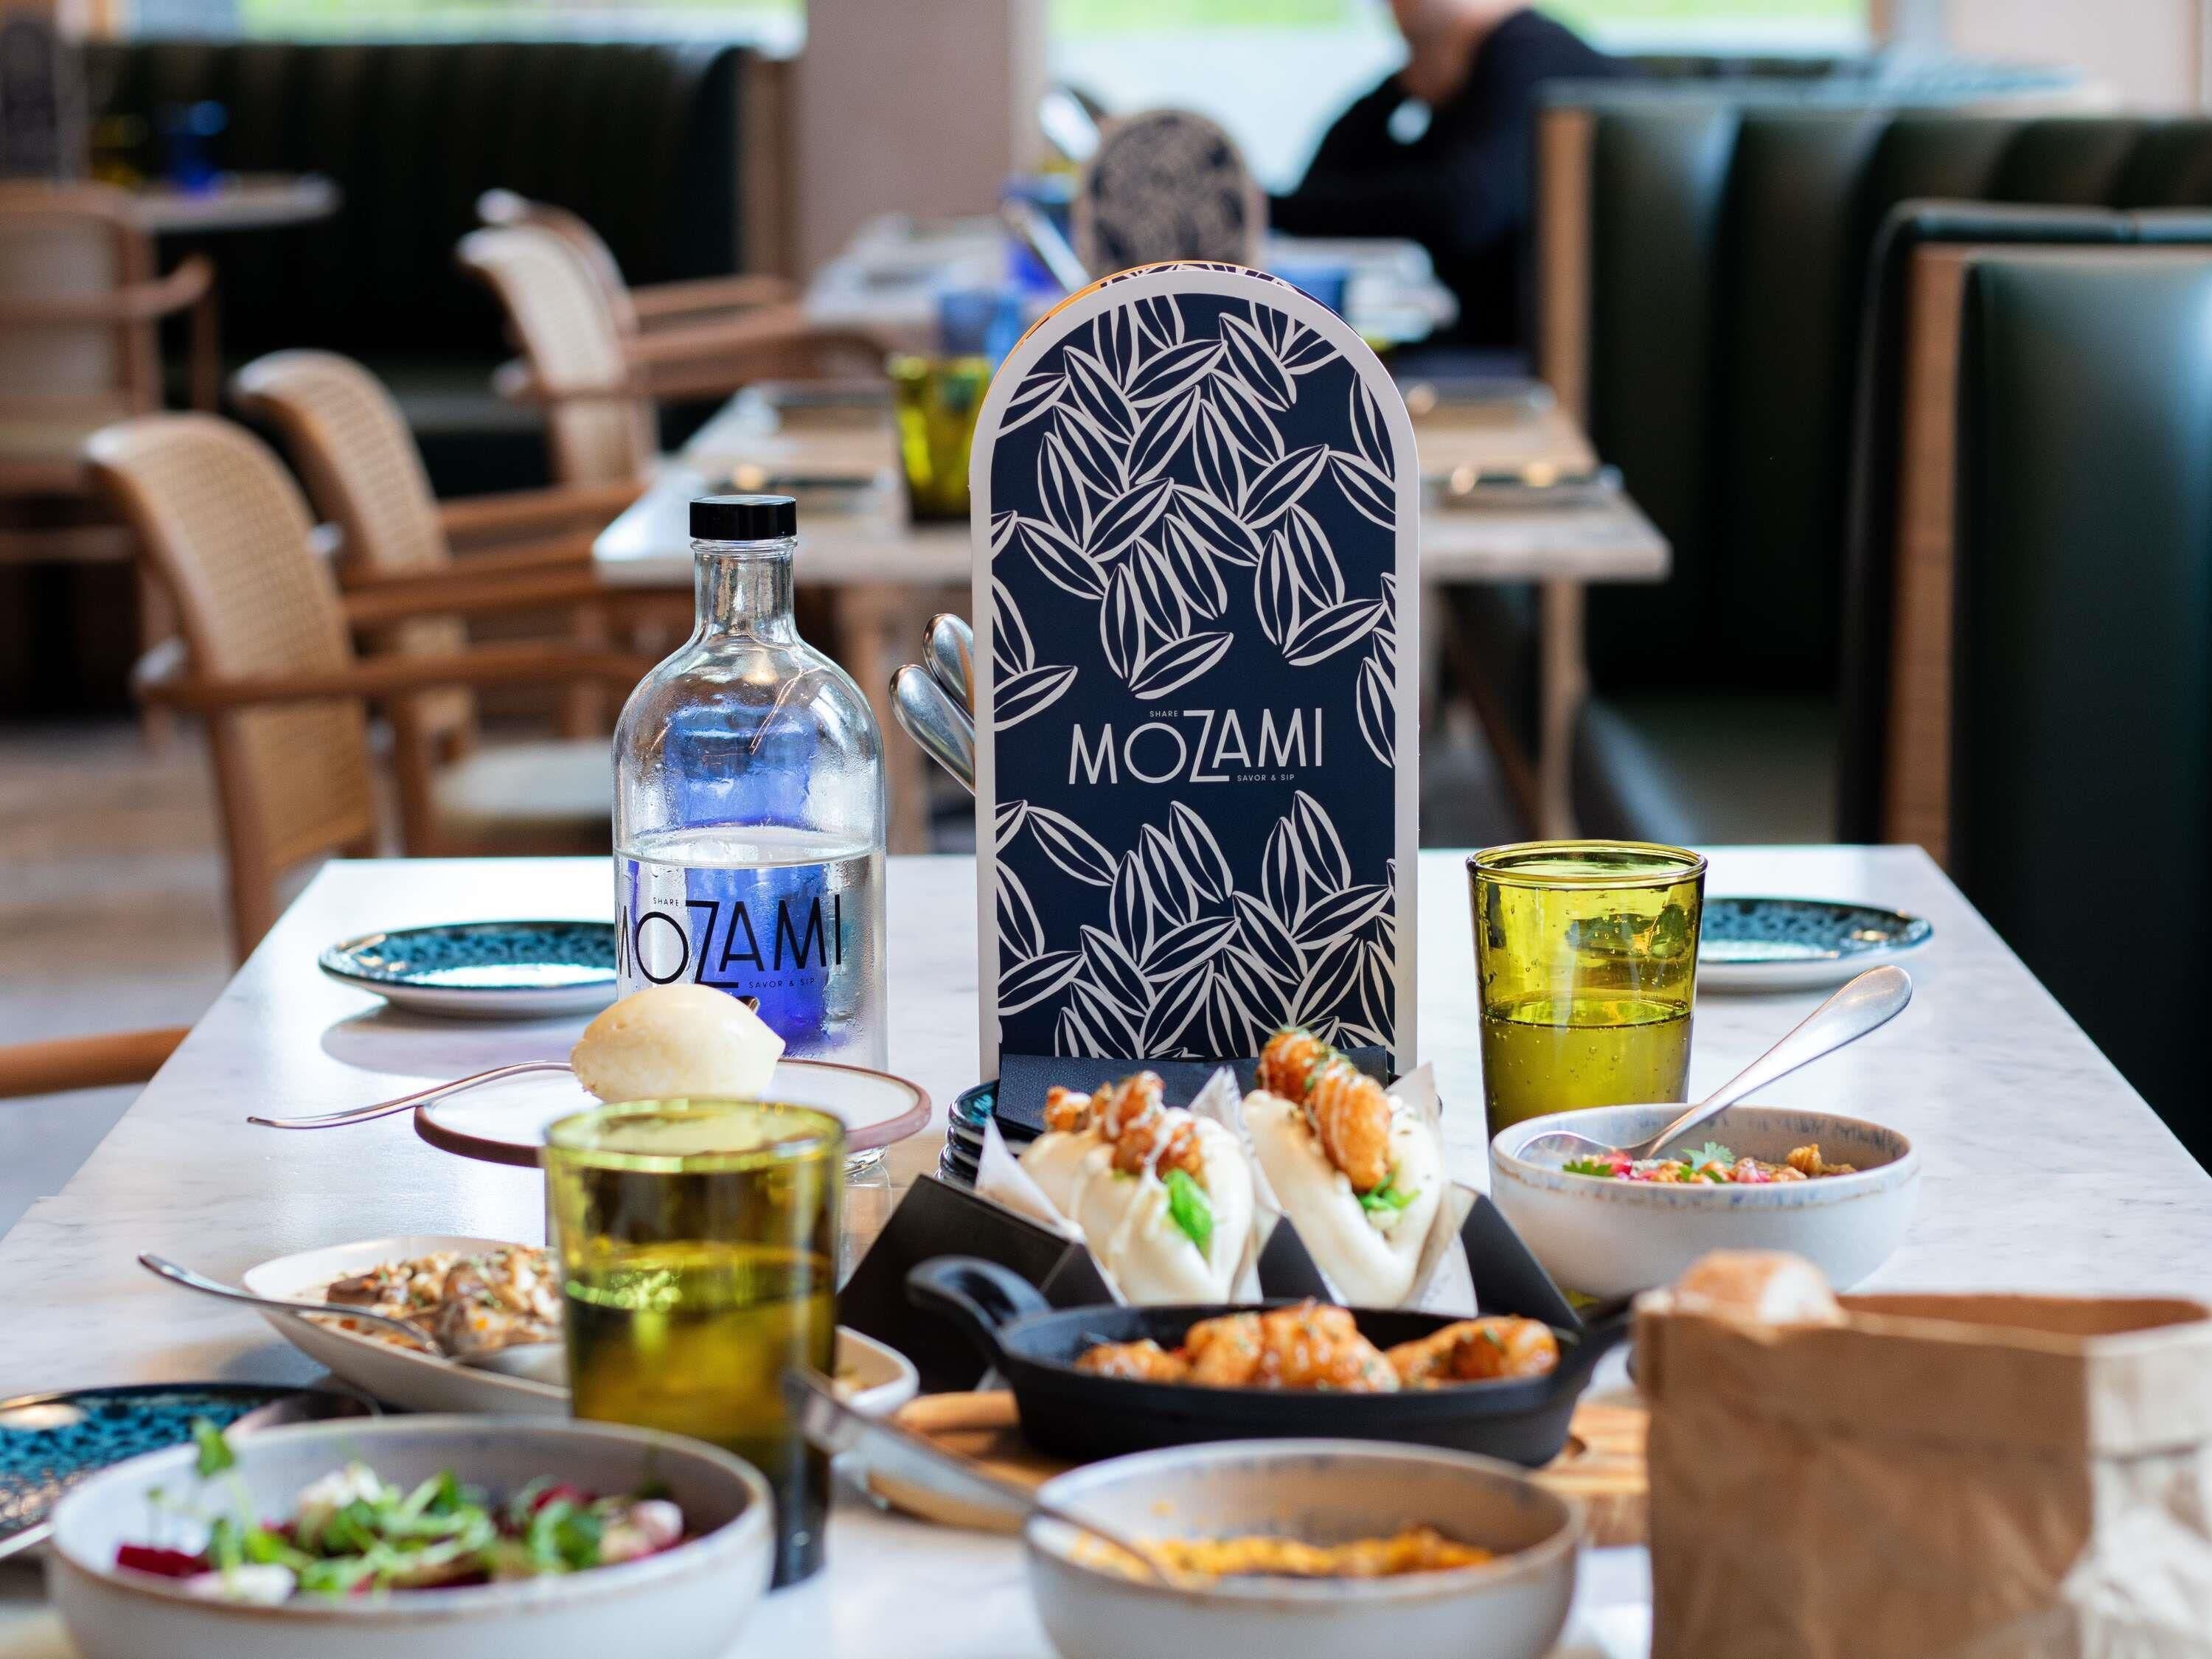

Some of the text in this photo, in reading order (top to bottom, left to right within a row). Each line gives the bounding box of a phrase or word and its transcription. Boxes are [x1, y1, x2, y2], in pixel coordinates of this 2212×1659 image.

[1068, 707, 1322, 785] MOZAMI
[653, 897, 679, 907] SHARE
[615, 894, 841, 989] MOZAMI
[748, 980, 782, 989] SAVOR
[800, 978, 815, 986] SIP
